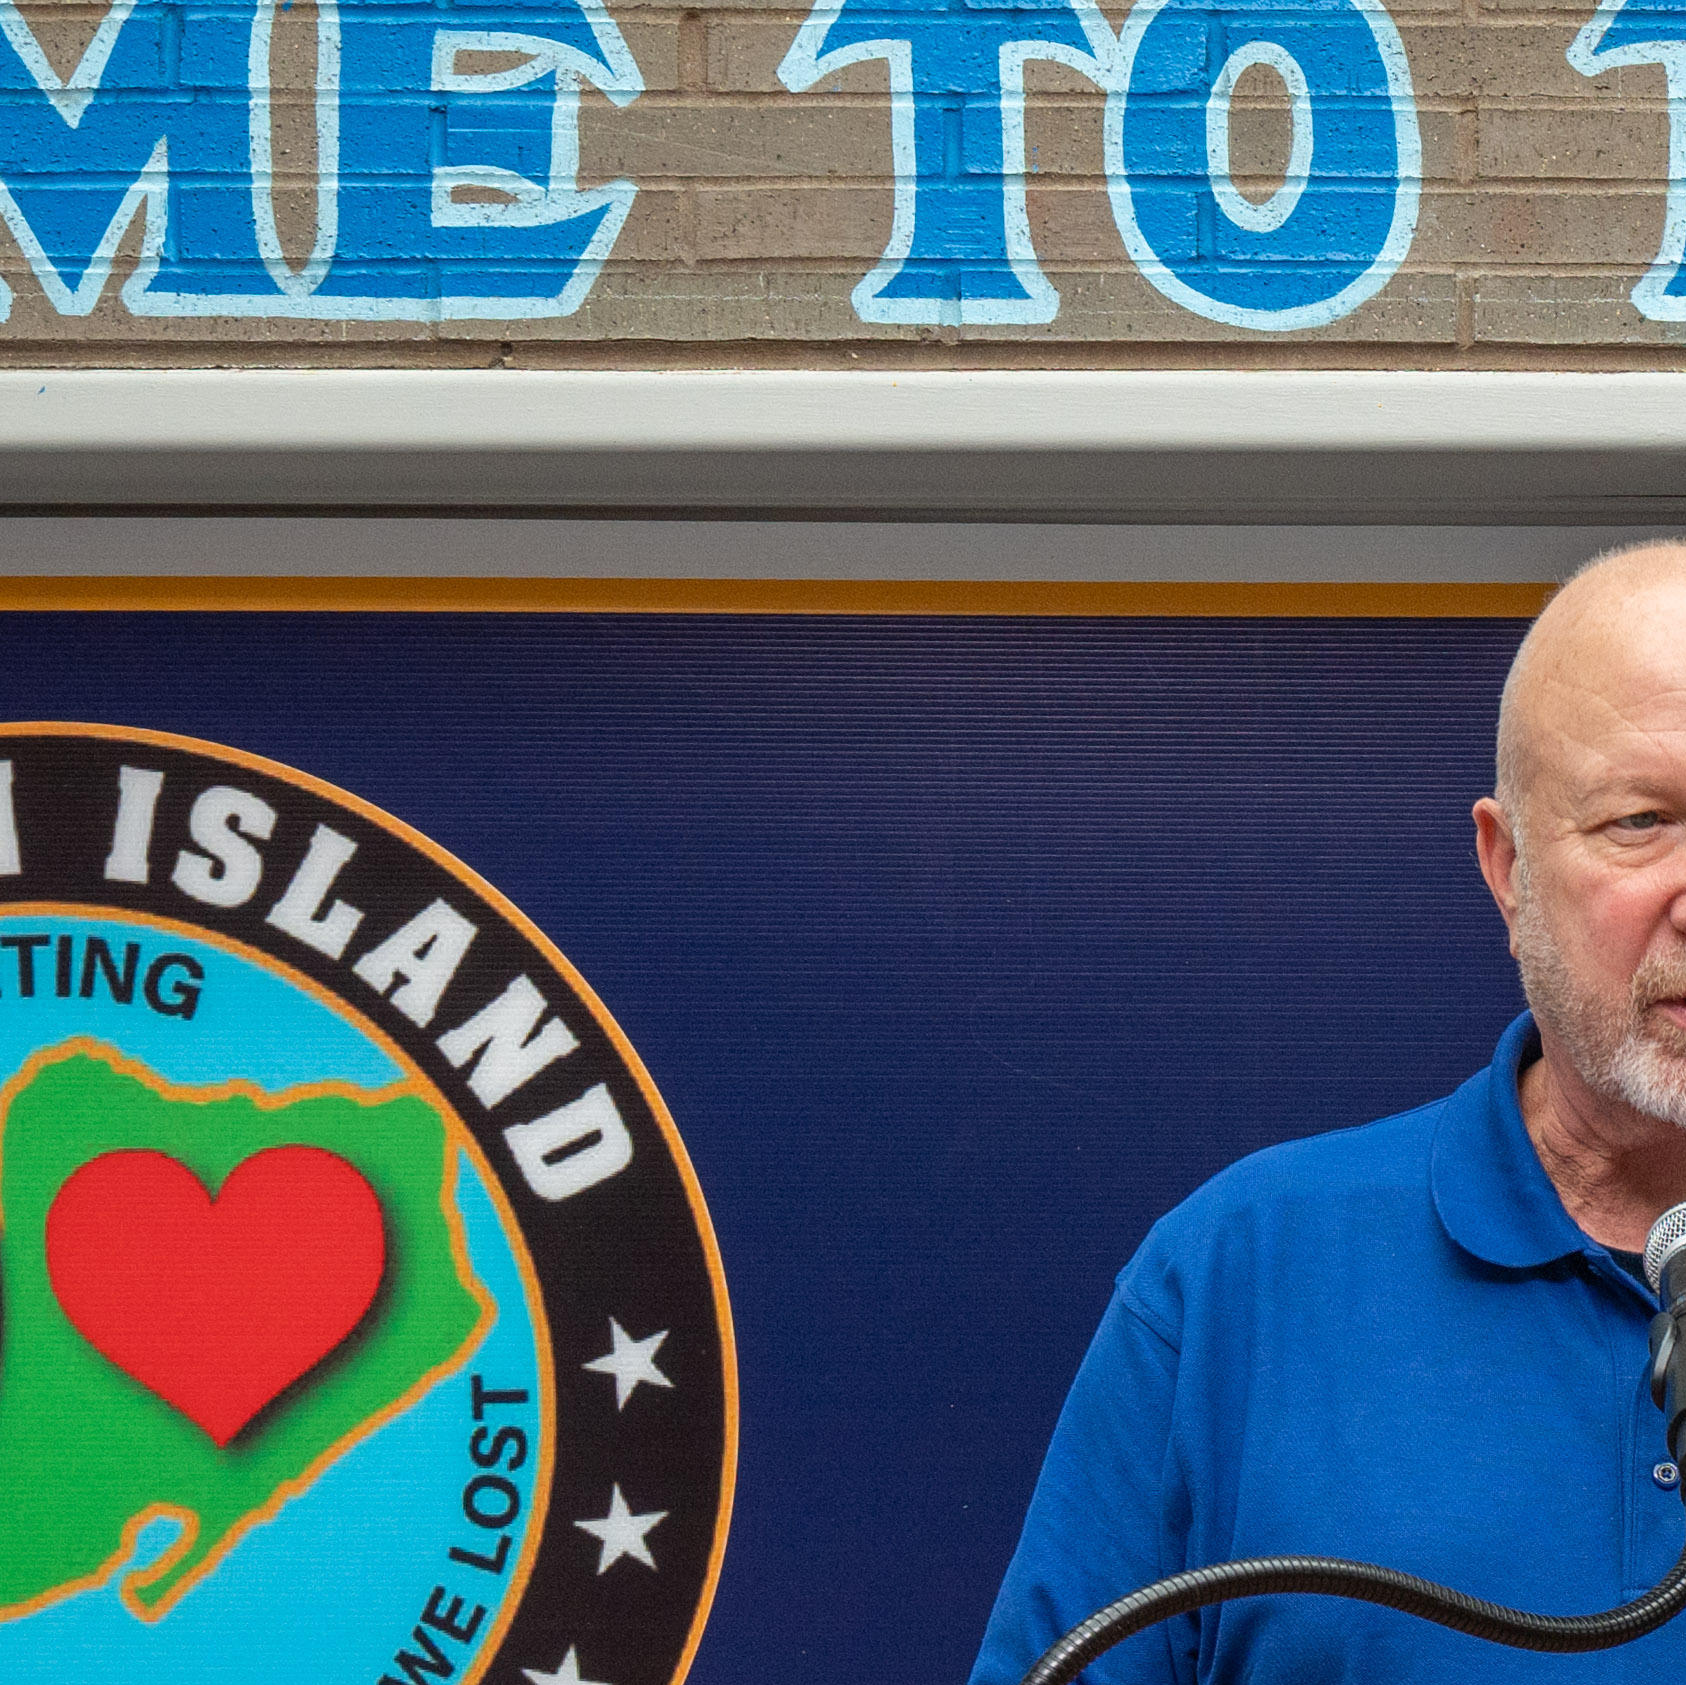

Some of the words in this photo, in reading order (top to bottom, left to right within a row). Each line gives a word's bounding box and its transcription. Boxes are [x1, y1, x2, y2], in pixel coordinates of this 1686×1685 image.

[778, 0, 1423, 330] TO
[0, 933, 206, 1021] TING
[103, 765, 635, 1203] ISLAND
[448, 1373, 531, 1577] LOST
